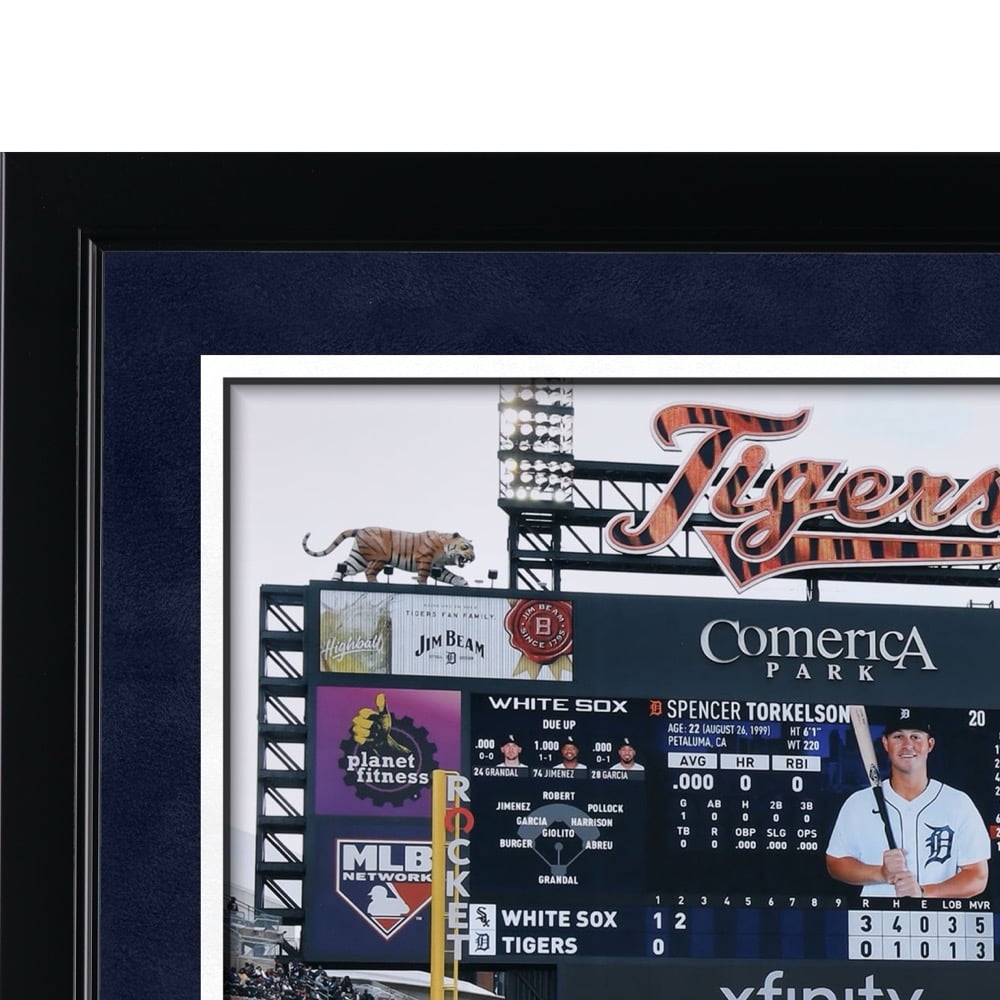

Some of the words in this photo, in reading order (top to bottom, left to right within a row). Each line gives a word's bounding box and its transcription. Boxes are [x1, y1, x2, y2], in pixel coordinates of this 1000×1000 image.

[522, 606, 536, 620] JIM
[538, 603, 565, 622] BEAM
[520, 627, 545, 648] SINCE
[548, 630, 566, 647] 1795
[323, 633, 384, 660] Highball
[766, 662, 874, 682] PARK
[488, 696, 569, 711] WHITE
[575, 699, 628, 713] SOX
[667, 699, 741, 720] SPENCER
[746, 702, 851, 723] TORKELSON
[543, 719, 561, 730] DUE
[563, 719, 576, 730] UP
[969, 709, 986, 727] 20
[668, 723, 688, 734] AGE:
[689, 723, 700, 734] 22
[736, 725, 749, 736] 26,
[750, 725, 771, 737] 1999)
[790, 726, 801, 736] HT
[668, 736, 713, 748] PETALUMA,
[715, 737, 727, 748] CA
[787, 740, 801, 750] WT
[803, 740, 820, 751] 220
[347, 752, 415, 771] planet
[680, 755, 707, 767] AVG
[736, 757, 755, 768] HR
[786, 758, 808, 769] RBI
[356, 767, 430, 785] fitness
[474, 767, 484, 776] 24
[485, 767, 518, 777] GRANDAL
[533, 769, 543, 778] 74
[544, 769, 574, 779] JIMENEZ
[591, 770, 601, 779] 28
[602, 771, 628, 780] GARCIA
[672, 772, 714, 791] .000
[543, 791, 576, 801] ROBERT
[496, 802, 531, 812] JIMENEZ
[588, 803, 624, 814] POLLOCK
[516, 816, 548, 826] GARCIA
[571, 817, 613, 827] HARRISON
[542, 828, 575, 838] GIOLITO
[735, 828, 756, 838] OBP
[766, 829, 787, 839] SLG
[797, 829, 818, 839] OPS
[499, 839, 533, 849] BURGER
[585, 840, 613, 850] ABREU
[342, 844, 433, 872] MLB
[444, 775, 475, 961] ROCKET
[342, 871, 433, 882] NETWORK
[538, 875, 579, 885] GRANDAL
[942, 900, 962, 910] LOB
[969, 900, 991, 910] MVR
[502, 909, 571, 928] WHITE
[575, 911, 618, 928] SOX
[502, 936, 578, 955] TIGERS
